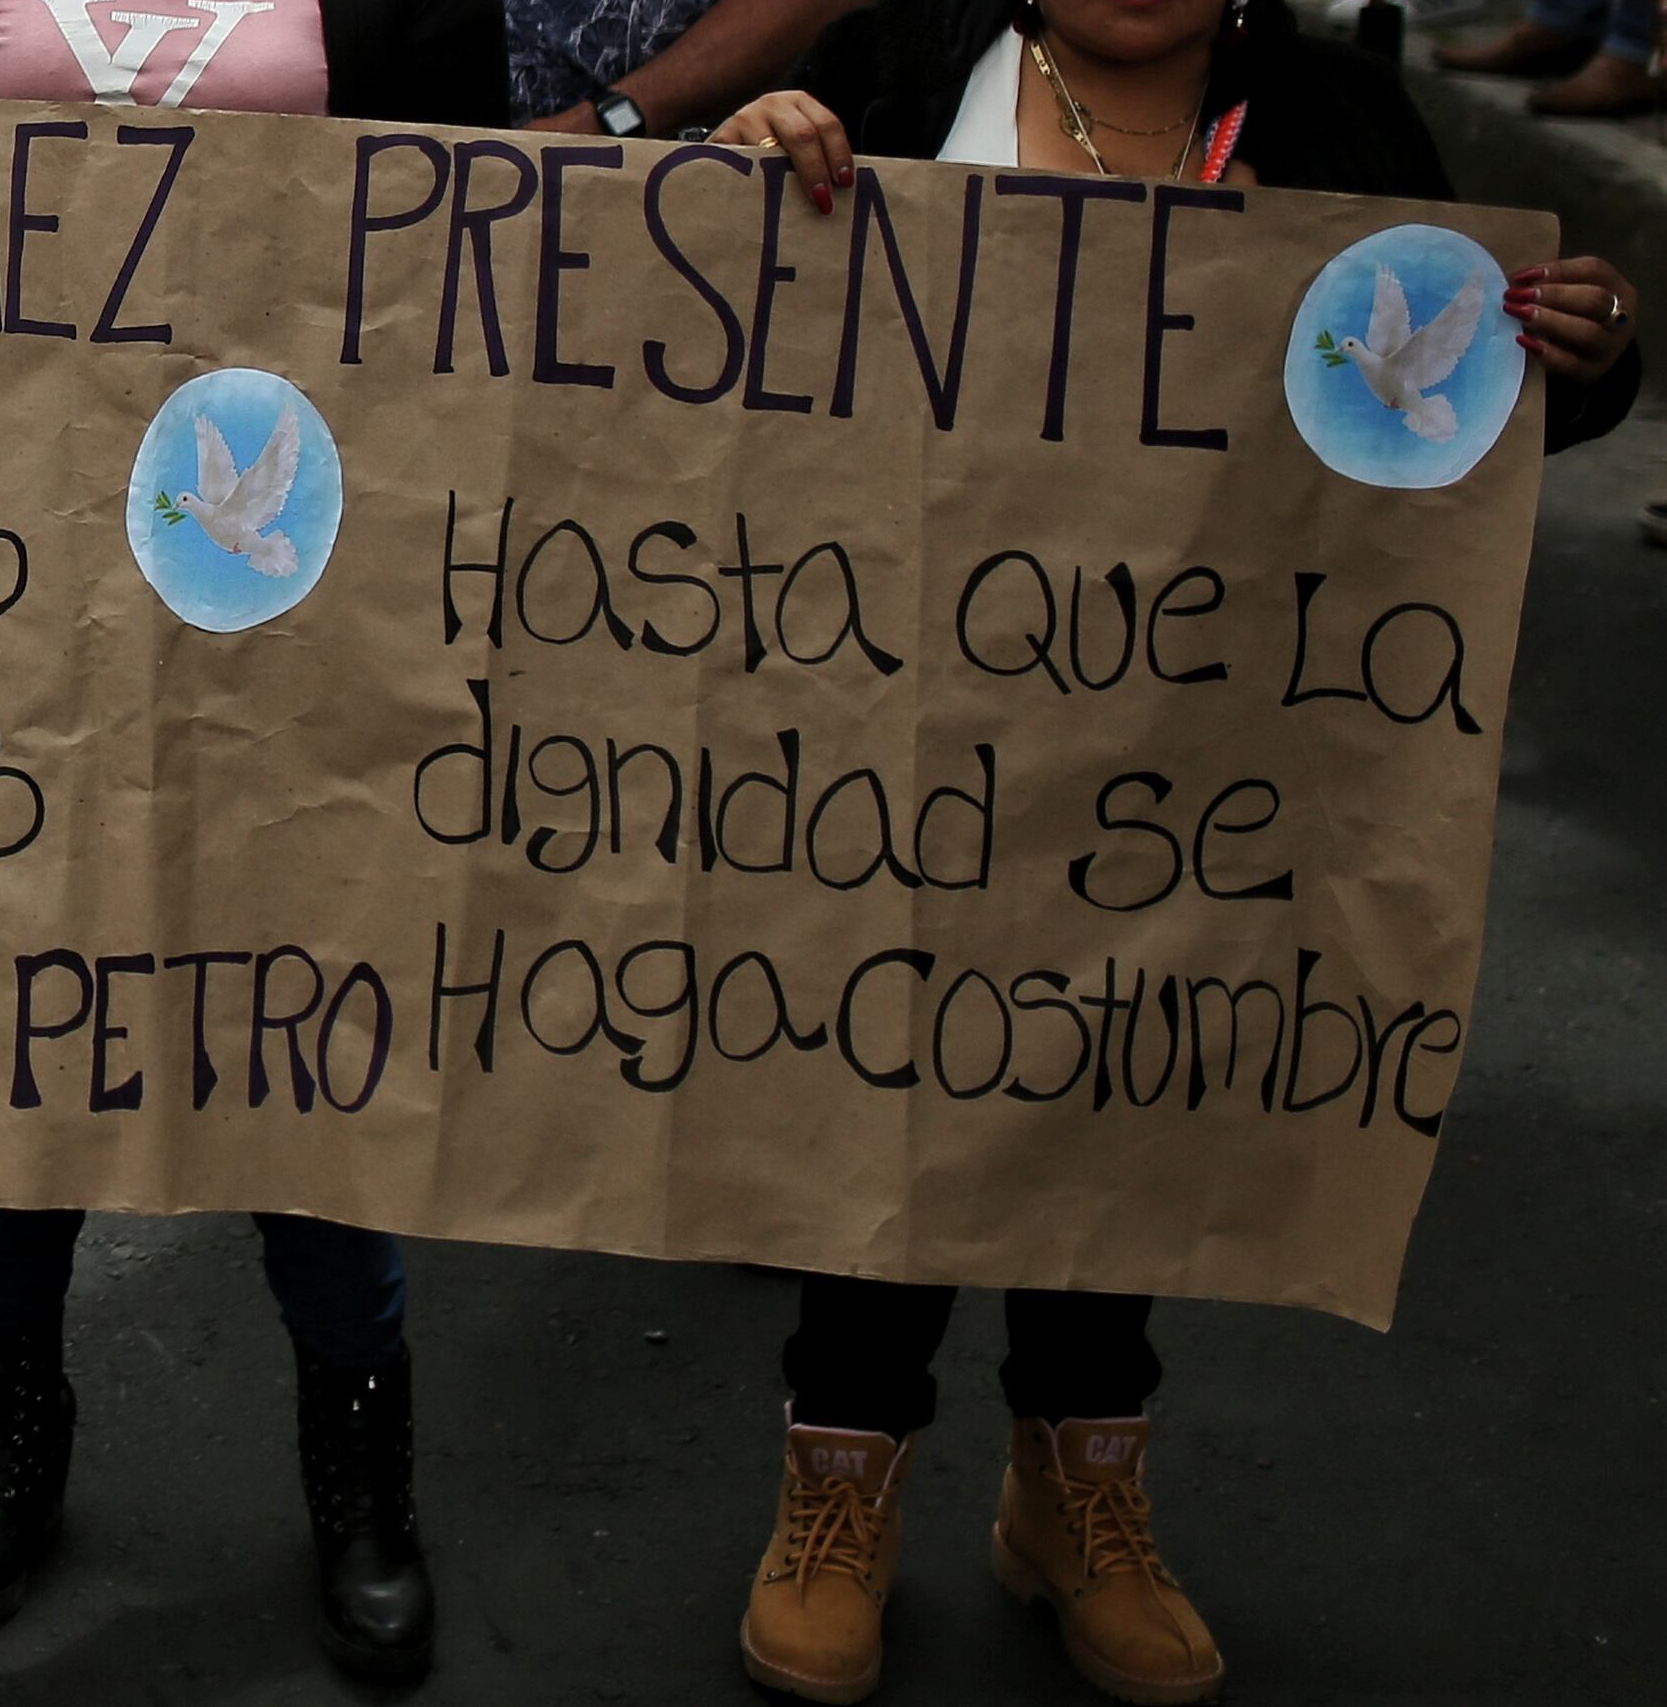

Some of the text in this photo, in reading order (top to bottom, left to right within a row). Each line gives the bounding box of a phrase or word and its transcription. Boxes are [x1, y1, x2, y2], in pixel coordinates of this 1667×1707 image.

[340, 134, 1244, 451] PRESENTE
[444, 490, 904, 676] Hasta
[414, 679, 994, 890] dignidad
[10, 944, 392, 1114] PETRO
[429, 922, 827, 1091] Haga
[811, 1448, 866, 1478] CAT
[1085, 1434, 1137, 1463] CAT
